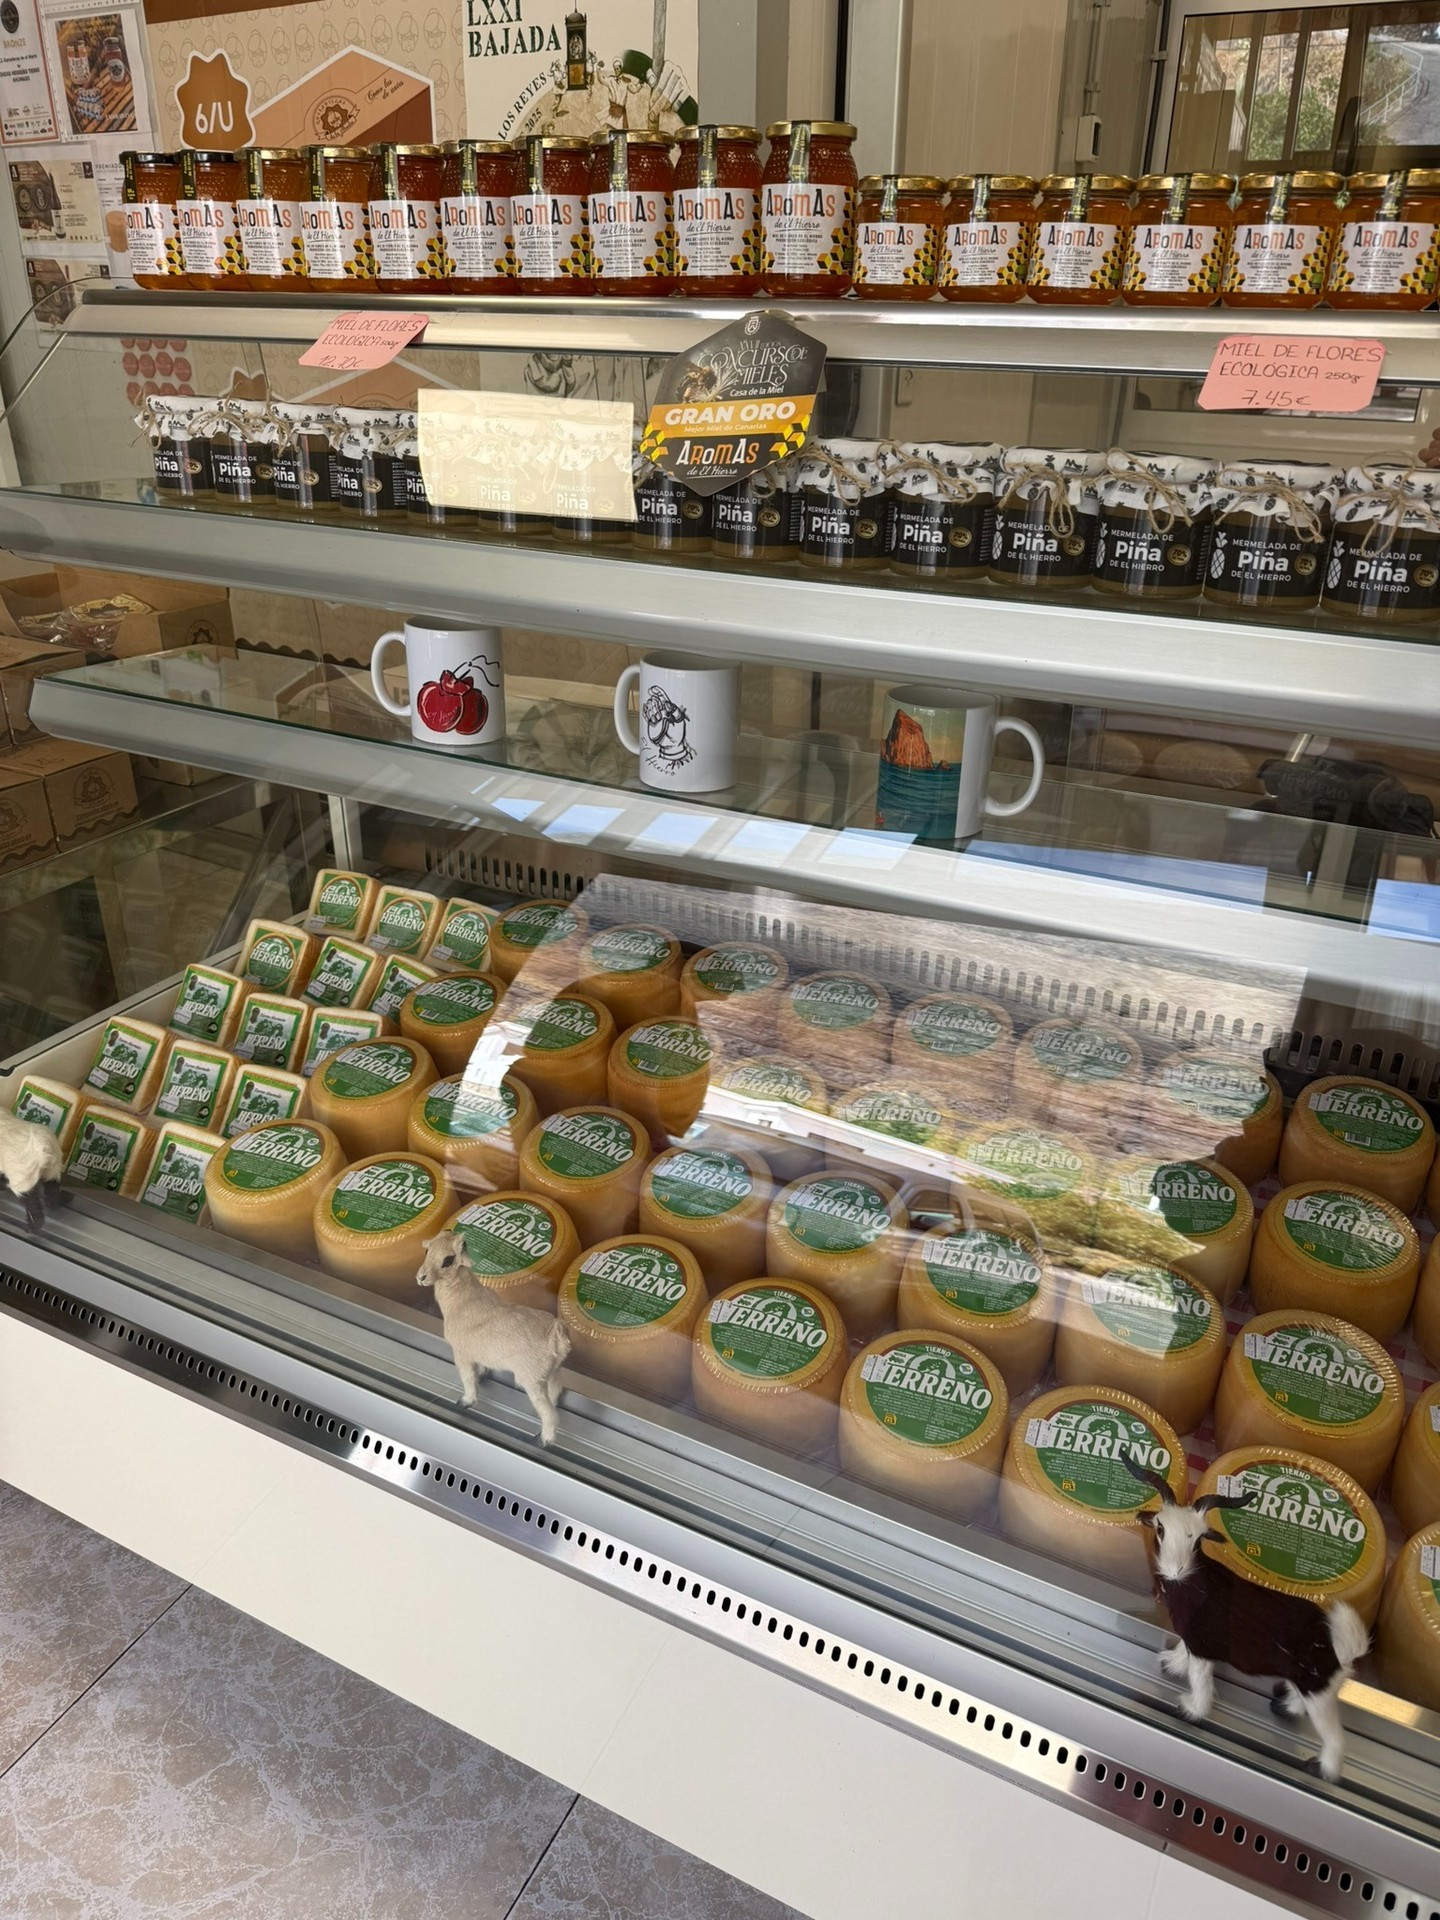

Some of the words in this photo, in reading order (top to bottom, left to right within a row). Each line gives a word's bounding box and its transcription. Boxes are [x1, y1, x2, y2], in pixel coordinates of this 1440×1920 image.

[467, 0, 523, 26] LXXI
[467, 24, 562, 58] BAJADA
[498, 112, 516, 140] LOS
[514, 72, 548, 112] REYES
[525, 108, 543, 134] 2025
[513, 198, 572, 225] AROMAS
[591, 195, 657, 223] AROMAS
[678, 191, 745, 221] AROMAS
[766, 188, 835, 217] AROMAS
[370, 203, 428, 229] AROMAS
[444, 200, 506, 226] AROMAS
[706, 221, 731, 232] Hierro
[794, 218, 820, 229] Hierro
[864, 225, 913, 246] AROMAS
[954, 224, 1007, 246] AROMAS
[1048, 225, 1104, 248] AROMAS
[1144, 227, 1203, 250] AROMAS
[1243, 227, 1305, 250] AROMAS
[1353, 225, 1419, 249] AROMAS
[331, 319, 358, 331] MIEL
[358, 319, 374, 331] DE
[375, 320, 422, 332] FLORES
[1220, 342, 1265, 357] MIEL
[1273, 343, 1298, 358] DE
[1306, 344, 1382, 362] FLORES
[739, 363, 789, 388] MIELES
[1219, 360, 1319, 380] ECOLÓGICA
[1324, 371, 1365, 384] 250gr
[730, 388, 747, 398] Casa
[748, 388, 759, 397] de
[759, 387, 767, 396] la
[767, 386, 784, 395] Miel
[1241, 389, 1312, 407] 7.45€
[665, 405, 735, 425] GRAN
[740, 401, 796, 421] ORO
[684, 425, 705, 434] Mejor
[735, 423, 767, 431] Canarias
[676, 438, 759, 465] AROMAS
[155, 457, 178, 472] Piña
[219, 462, 252, 477] Piña
[687, 467, 697, 475] de
[699, 465, 710, 475] El
[711, 465, 738, 475] Hierro
[406, 478, 433, 495] Piña
[480, 485, 512, 501] Piña
[556, 493, 589, 510] Piña
[641, 498, 678, 516] Piña
[752, 498, 762, 506] DE
[808, 506, 848, 516] MERMELADA
[850, 508, 860, 516] DE
[655, 516, 682, 524] HIERRO
[719, 505, 753, 523] Piña
[901, 513, 941, 524] MERMELADA
[732, 523, 757, 532] HIERRO
[812, 516, 851, 536] Piña
[903, 524, 943, 544] Piña
[1111, 529, 1160, 541] MERMELADA
[1162, 534, 1174, 542] DE
[808, 534, 815, 542] DE
[817, 535, 824, 543] EL
[826, 536, 854, 545] HIERRO
[900, 542, 907, 550] DE
[917, 544, 947, 553] HIERRO
[1013, 532, 1058, 552] Piña
[1232, 538, 1287, 551] MERMELADA
[1289, 542, 1301, 551] DE
[1007, 551, 1017, 560] DE
[1018, 552, 1028, 560] EL
[1030, 553, 1061, 562] HIERRO
[1115, 540, 1161, 562] Piña
[1350, 547, 1407, 560] MERMELADA
[1410, 552, 1422, 562] DE
[1110, 559, 1119, 568] DE
[1121, 560, 1131, 569] EL
[1132, 562, 1165, 572] HIERRO
[1238, 550, 1289, 572] Piña
[1231, 570, 1241, 578] DE
[1244, 571, 1254, 579] EL
[1257, 572, 1291, 582] HIERRO
[1354, 560, 1408, 582] Piña
[1346, 580, 1358, 588] DE
[1360, 581, 1371, 590] EL
[1373, 583, 1410, 594] HIERRO
[320, 892, 361, 907] HERREÑO
[381, 912, 425, 933] HERREÑO
[444, 922, 489, 947] HERREÑO
[251, 948, 294, 970] HERREÑO
[317, 972, 353, 993] HERREÑO
[184, 1000, 220, 1019] HERREÑO
[245, 1032, 286, 1050] HERREÑO
[100, 1056, 139, 1079] HERREÑO
[170, 1084, 211, 1103] HERREÑO
[78, 1151, 121, 1173] HERREÑO
[157, 1173, 202, 1196] HERREÑO
[925, 1346, 951, 1357] TIERNO
[1092, 1405, 1120, 1417] TIERNO
[1280, 1466, 1311, 1481] TIERNO
[1243, 1492, 1366, 1544] ERREÑO
